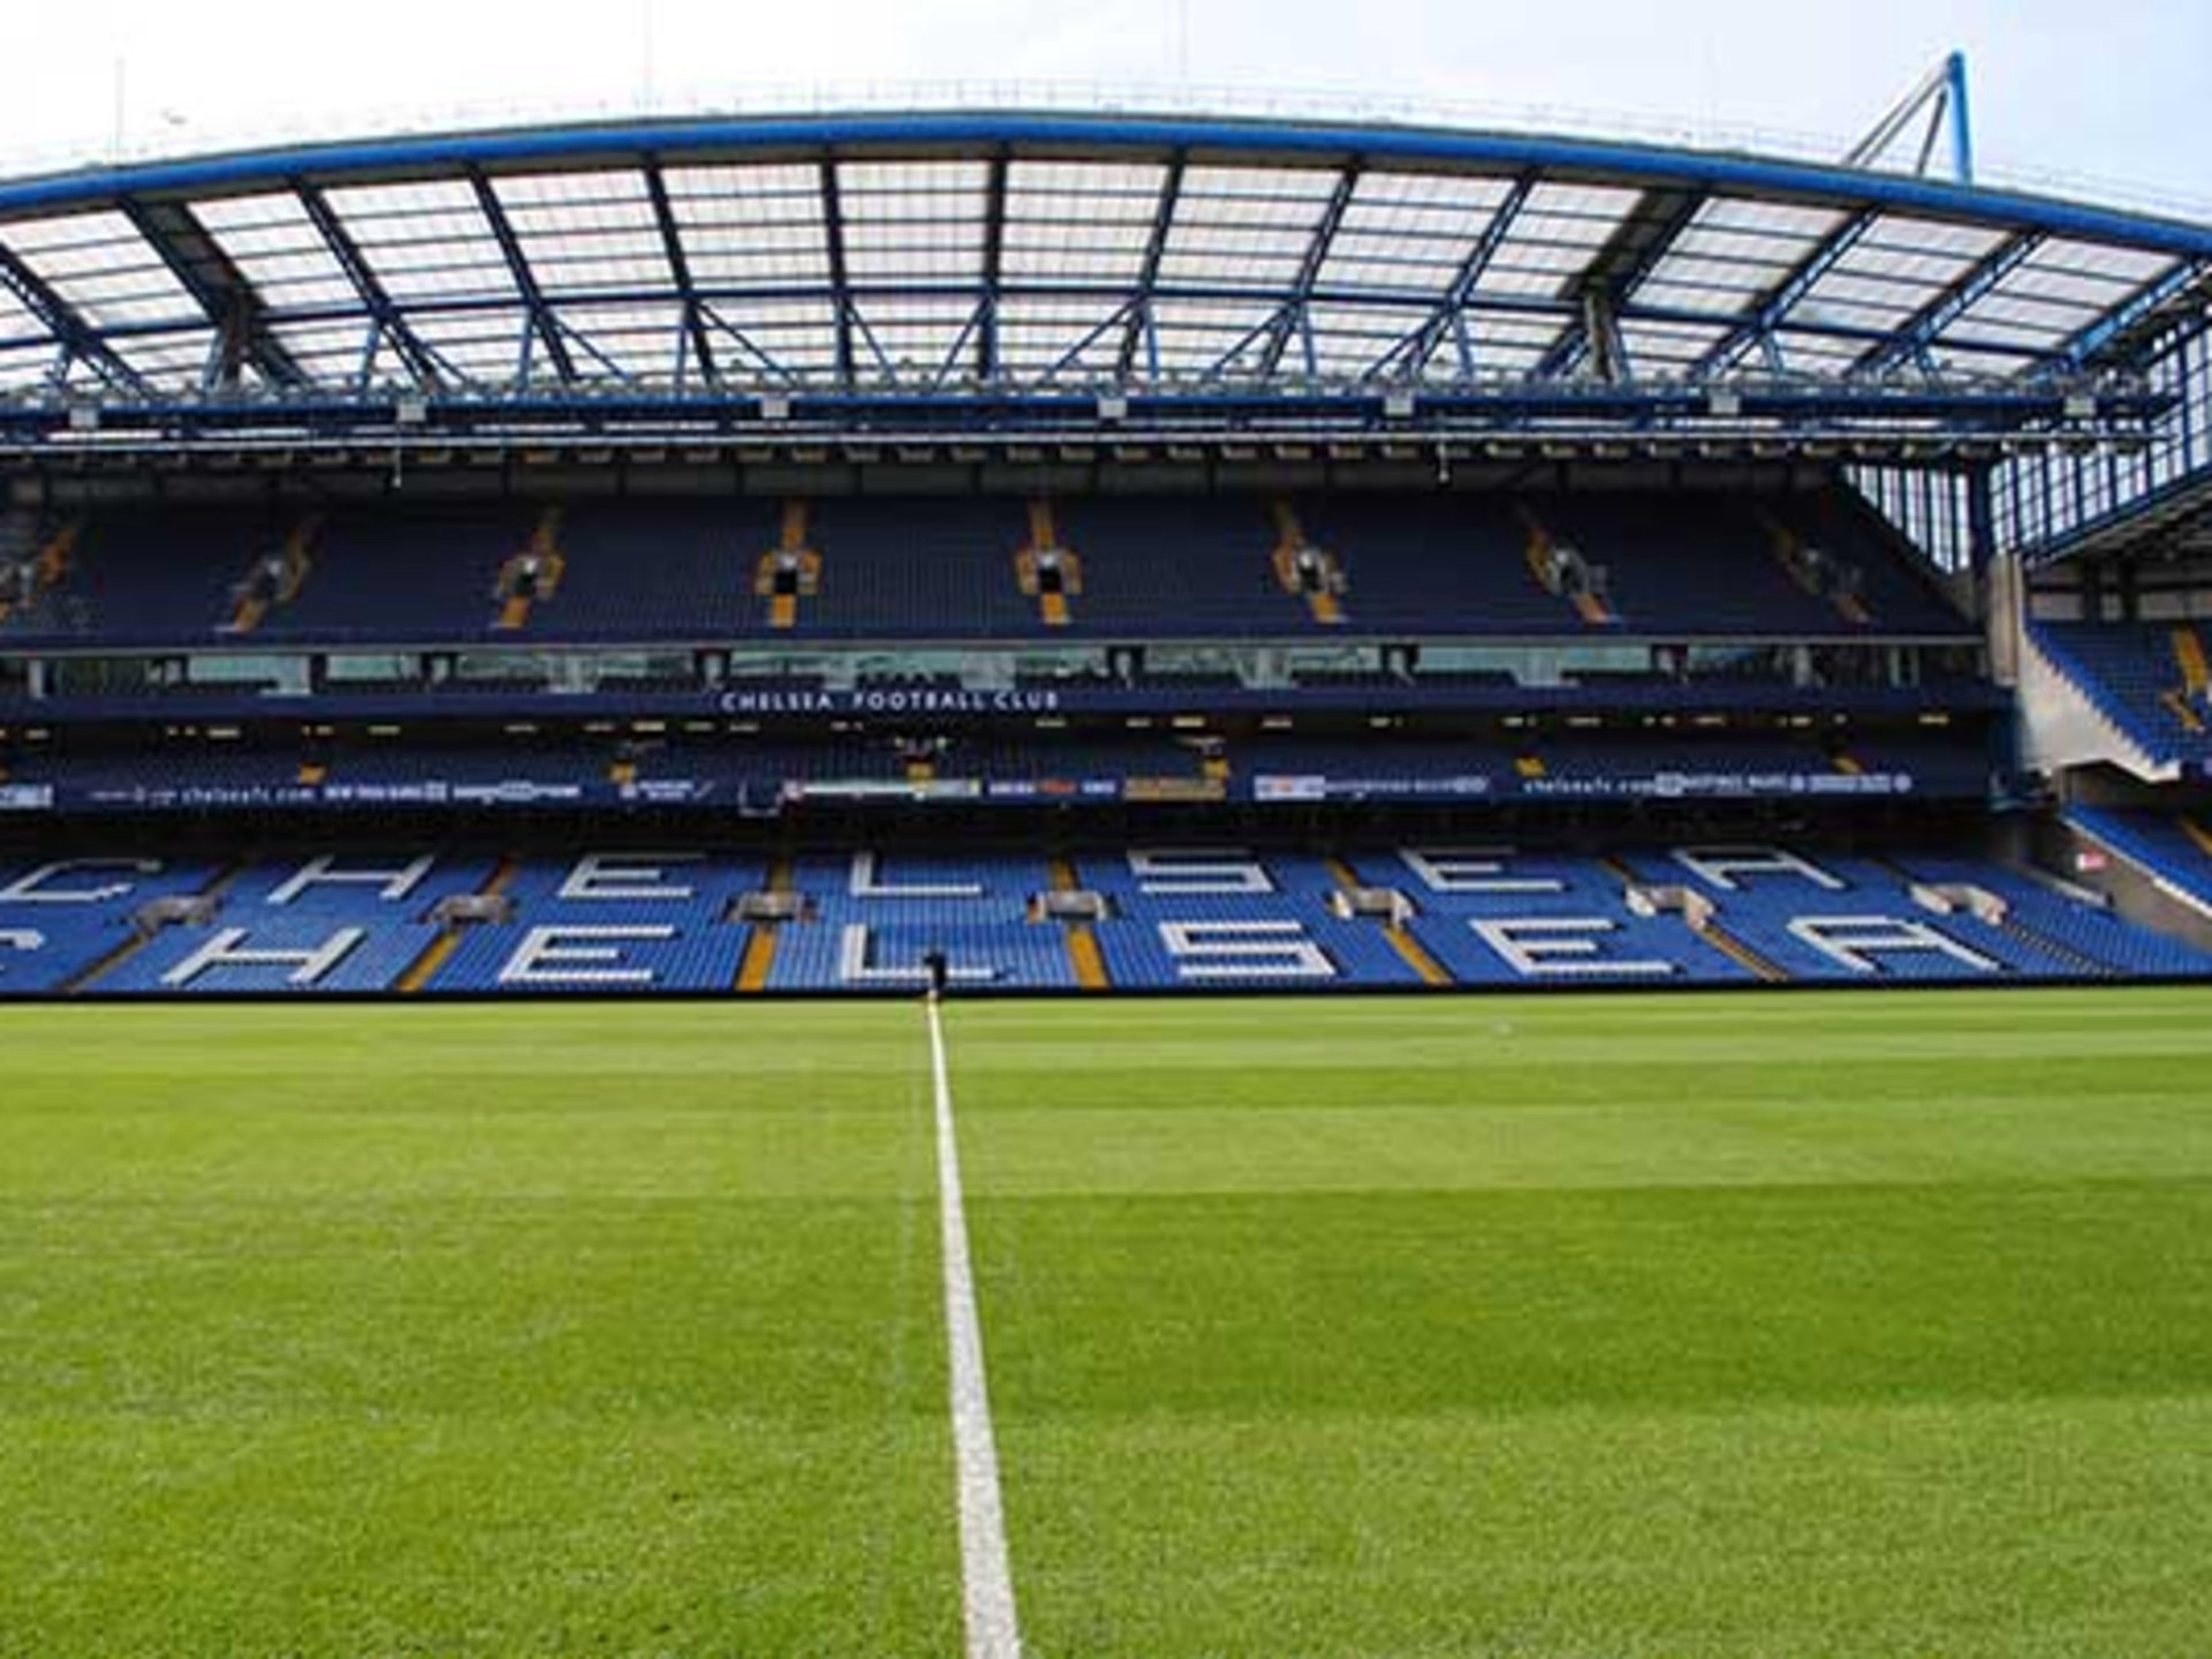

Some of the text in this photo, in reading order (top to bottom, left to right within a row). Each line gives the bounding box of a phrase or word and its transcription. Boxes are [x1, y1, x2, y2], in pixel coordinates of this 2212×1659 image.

[721, 691, 1058, 711] CHELSEA FOOTBALL CLUB
[0, 847, 1845, 903] CHELSEA
